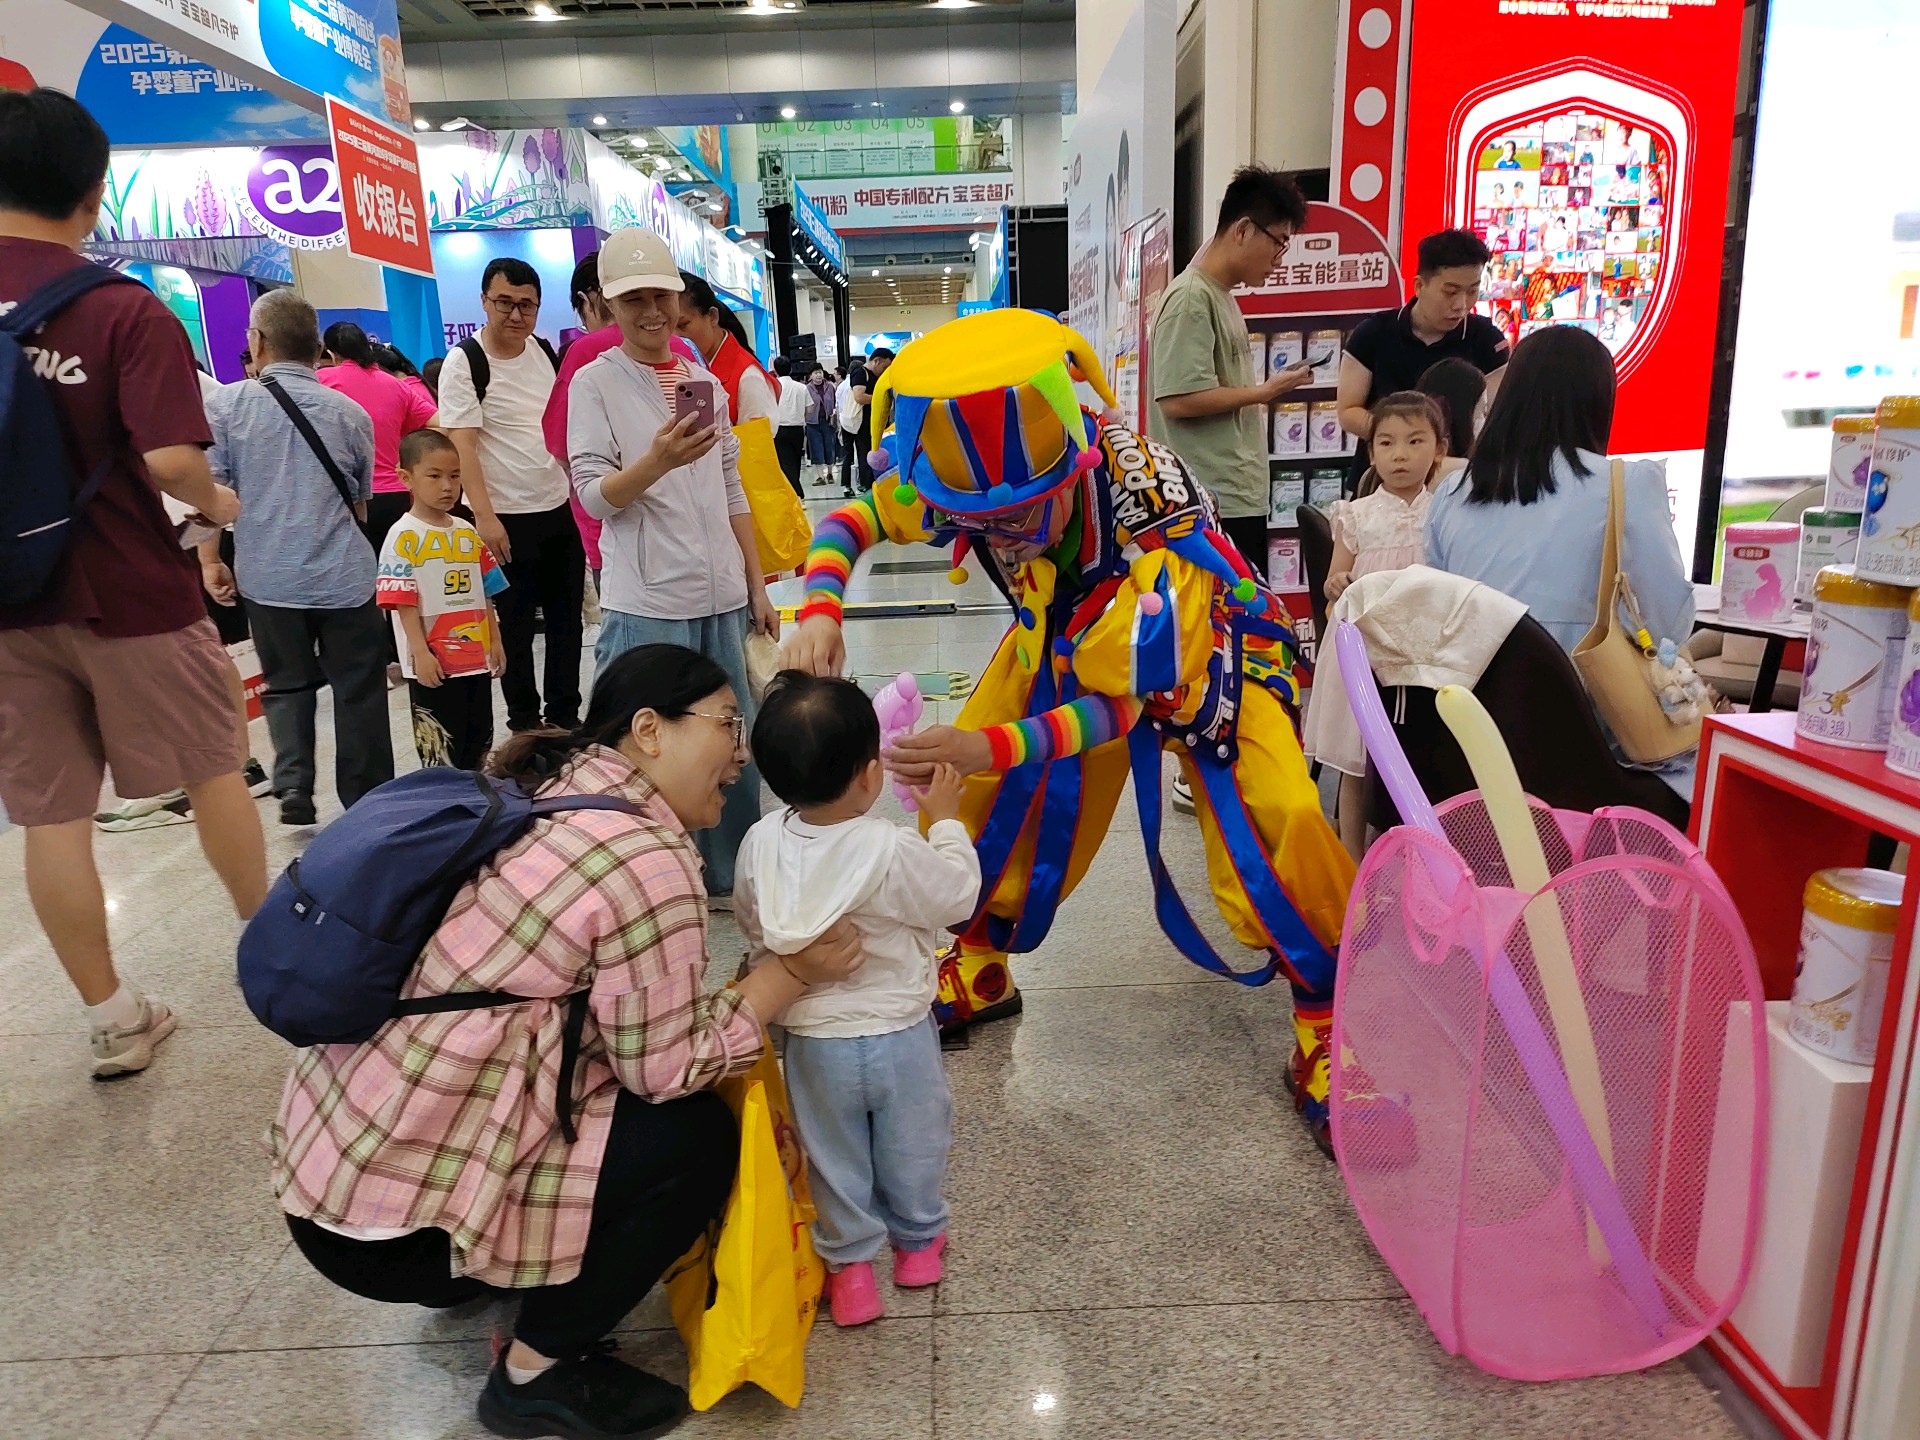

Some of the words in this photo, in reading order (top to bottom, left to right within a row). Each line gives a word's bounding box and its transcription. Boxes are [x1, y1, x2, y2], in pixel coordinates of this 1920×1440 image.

[100, 43, 204, 65] 2025第
[130, 69, 264, 96] 孕婴童产业
[239, 197, 266, 232] FEEL
[270, 227, 296, 246] THE
[302, 231, 347, 248] DIFFE
[353, 173, 419, 247] 收银台
[445, 570, 471, 595] 95
